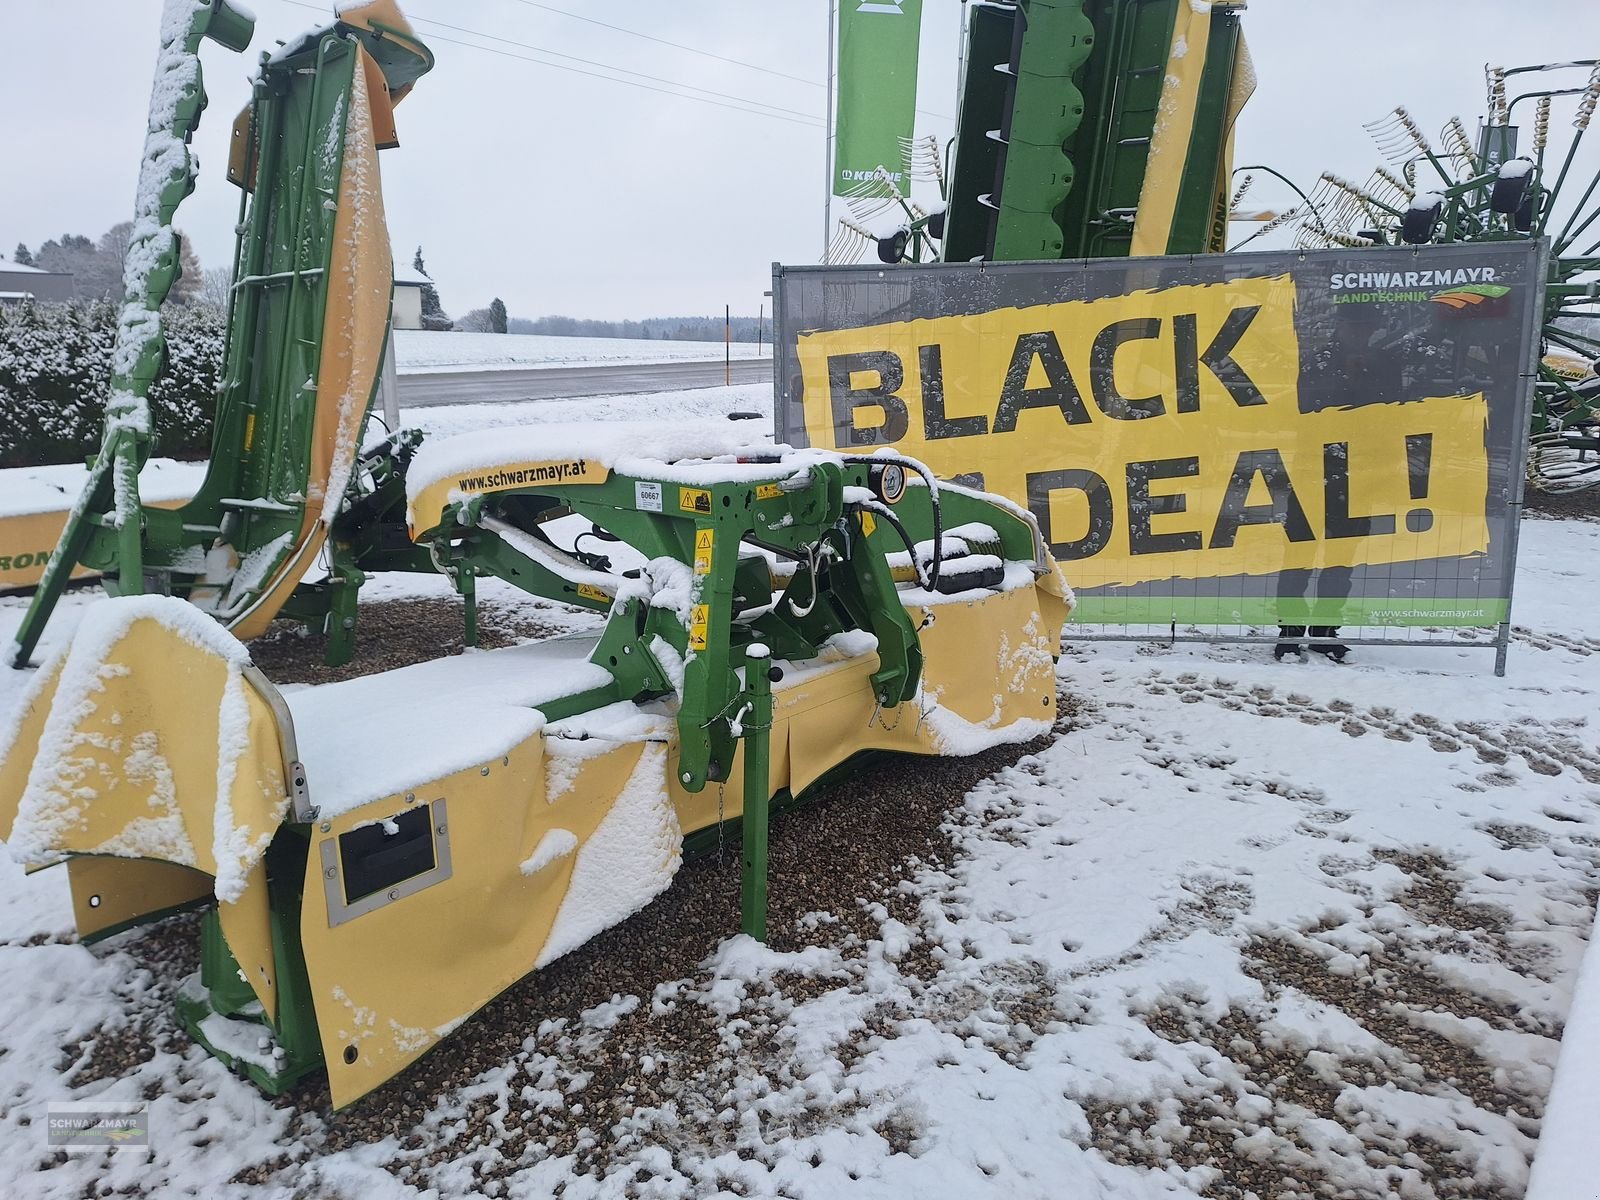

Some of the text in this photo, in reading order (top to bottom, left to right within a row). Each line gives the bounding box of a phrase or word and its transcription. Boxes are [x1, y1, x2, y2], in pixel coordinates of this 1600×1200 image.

[1209, 191, 1227, 253] RONE
[1330, 267, 1495, 290] SCHWARZMAYR
[1333, 291, 1428, 304] LANDTECHNIK
[828, 304, 1268, 449] BLACK
[459, 459, 586, 491] www.schwarzmayr.at
[1026, 432, 1434, 562] DEAL!
[1371, 609, 1484, 619] www.schwarzmayr.at
